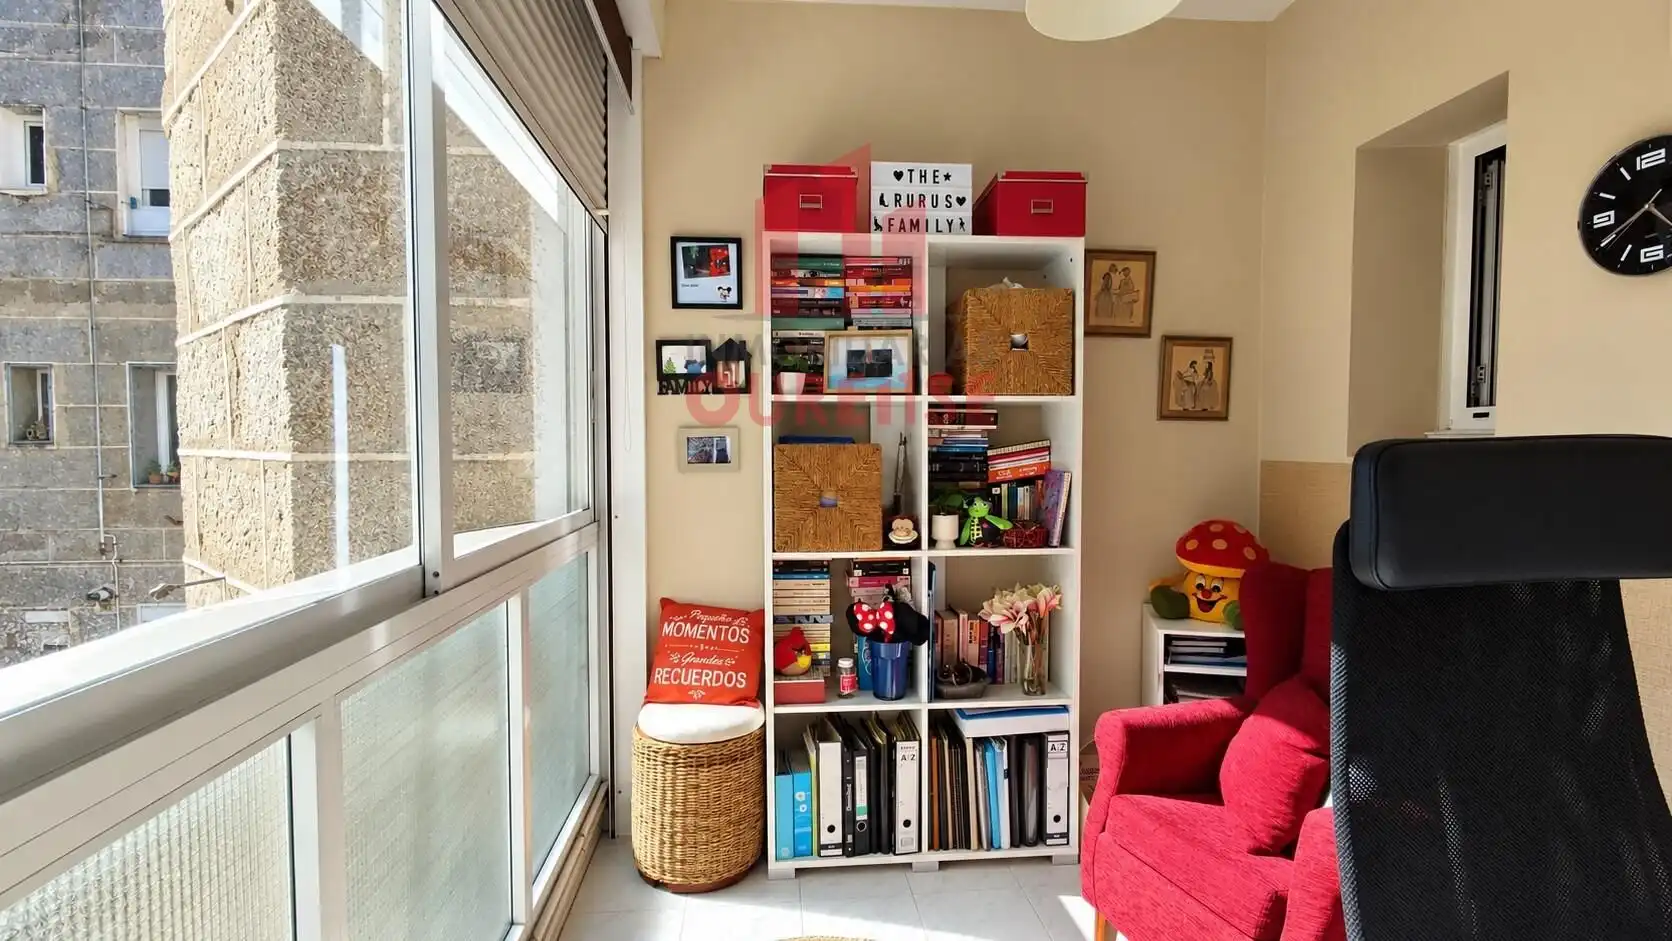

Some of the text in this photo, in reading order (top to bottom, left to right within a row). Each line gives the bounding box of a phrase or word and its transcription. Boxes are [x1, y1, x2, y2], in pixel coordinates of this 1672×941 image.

[1636, 148, 1666, 171] 12
[907, 168, 940, 184] THE
[894, 193, 952, 209] RURUS
[887, 217, 954, 233] FAMILY
[1593, 210, 1615, 229] 9
[657, 379, 712, 395] FAMILY
[661, 621, 751, 644] MOMENTOS
[681, 651, 725, 667] Grandes
[654, 667, 747, 689] RECUERDOS
